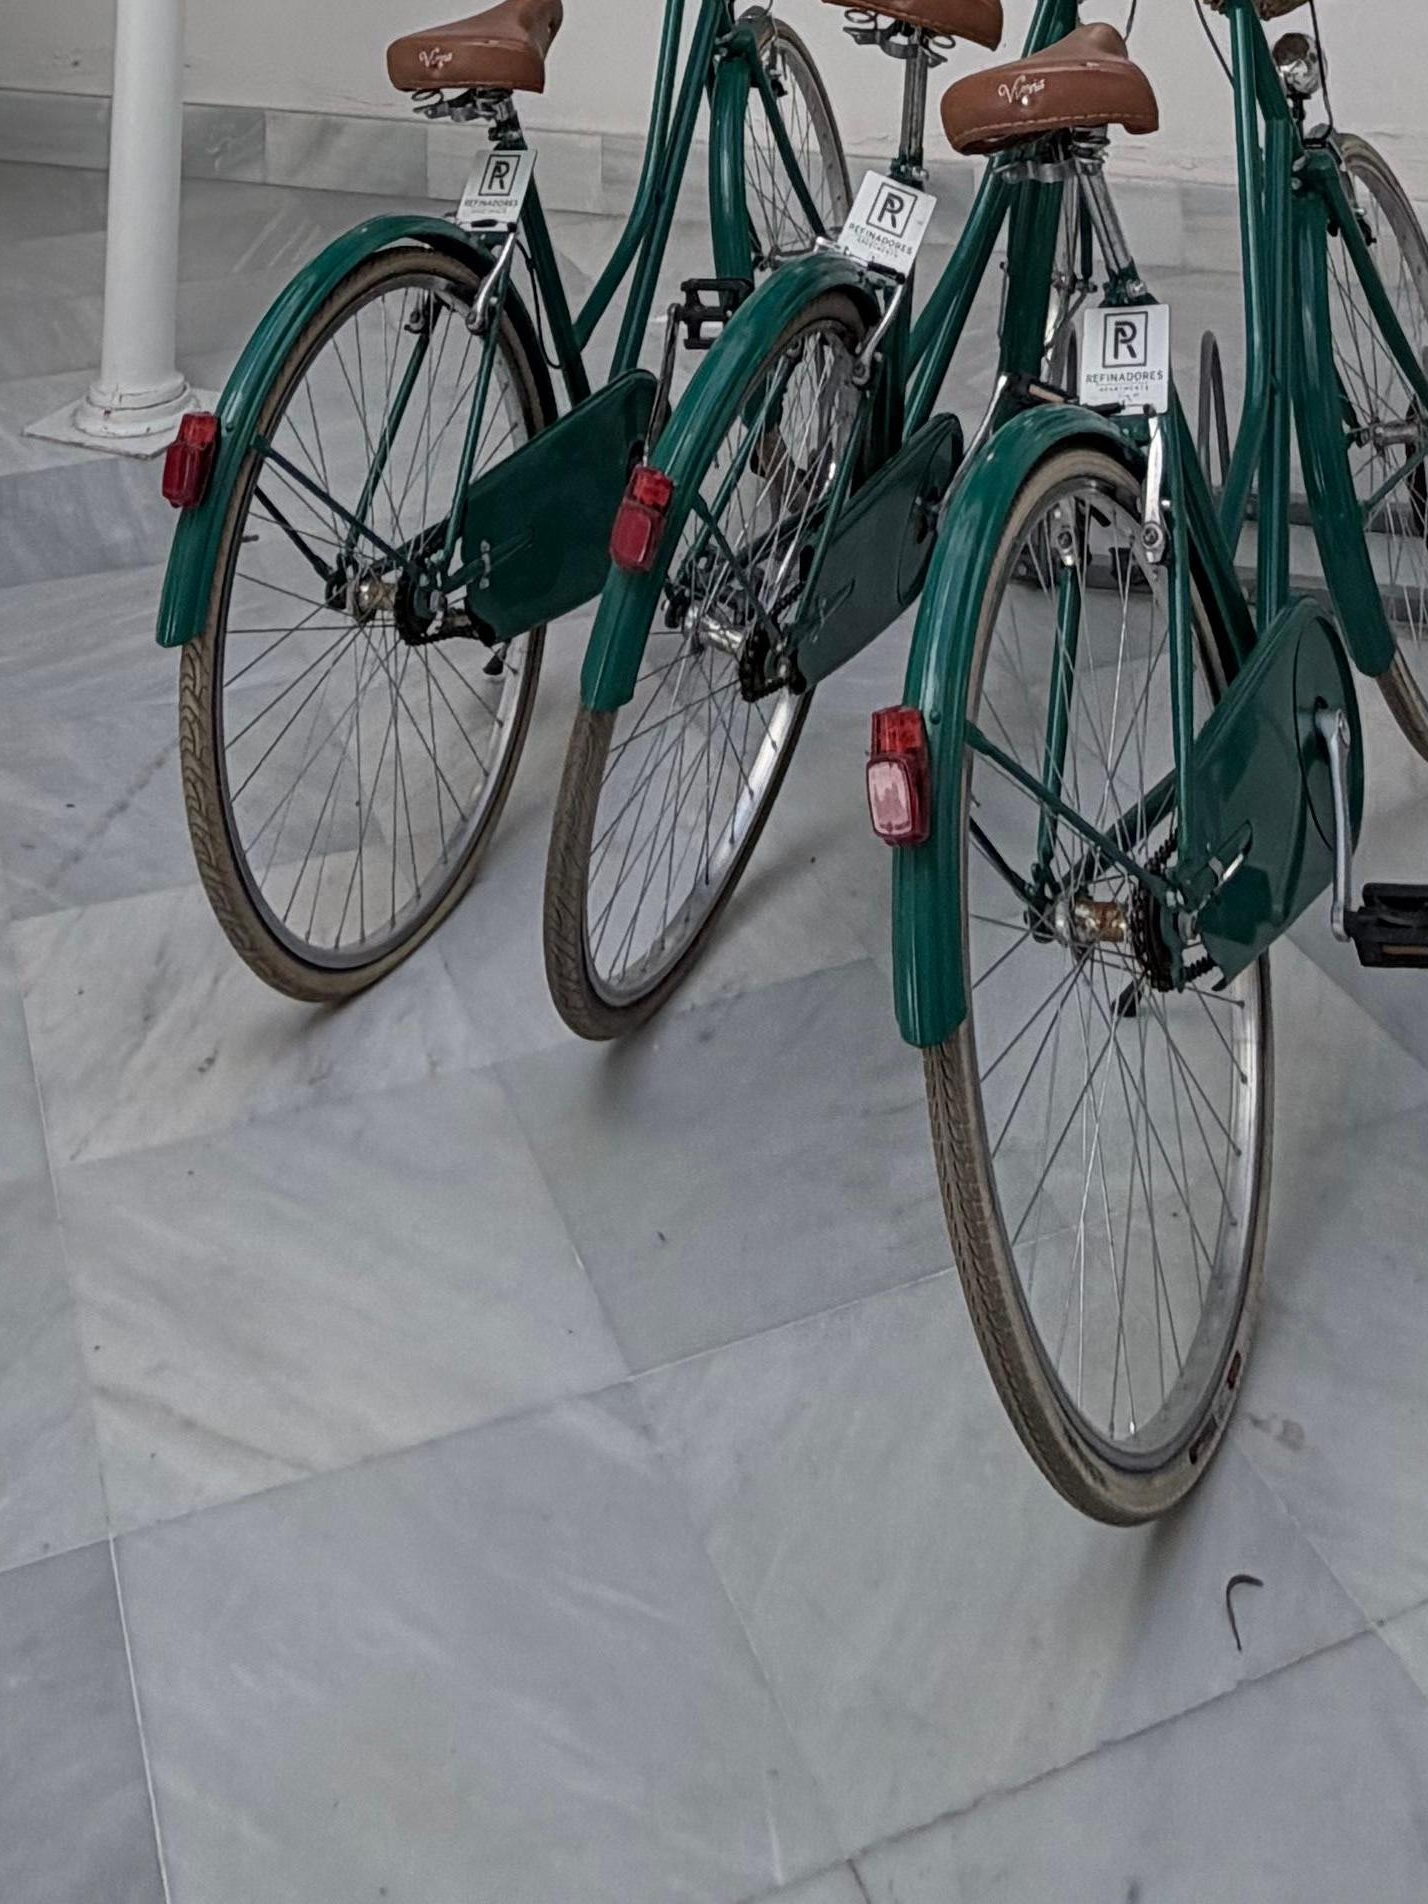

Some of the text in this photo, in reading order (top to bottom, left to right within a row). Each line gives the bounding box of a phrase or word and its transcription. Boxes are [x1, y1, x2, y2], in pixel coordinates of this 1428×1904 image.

[487, 160, 511, 190] R
[877, 192, 905, 229] R
[848, 223, 913, 255] REFINADORES
[1113, 320, 1138, 360] R
[1085, 370, 1164, 383] REFINADORES
